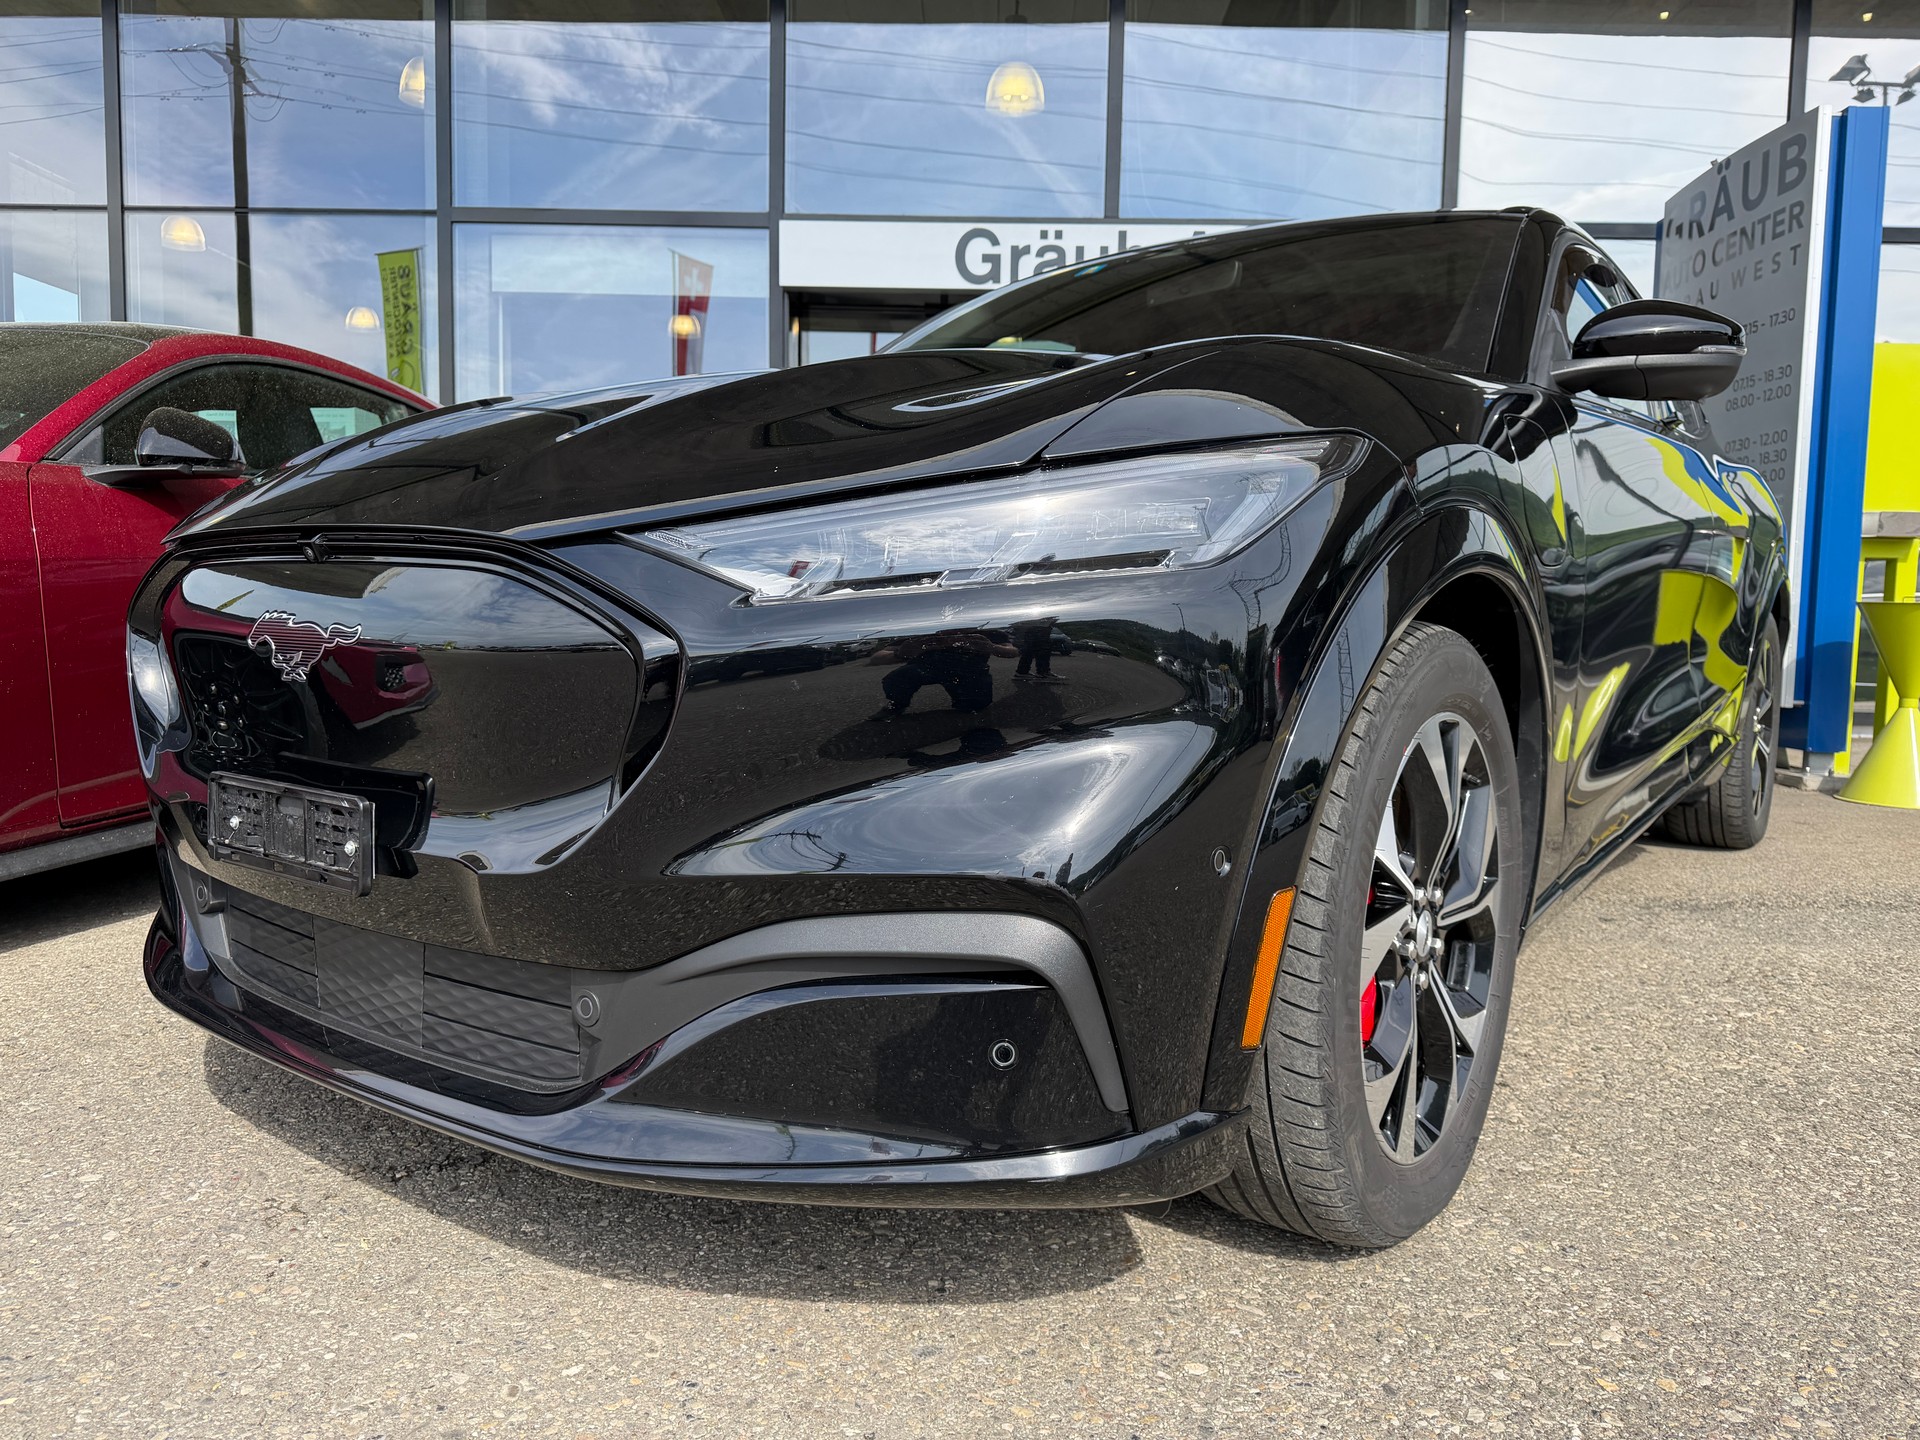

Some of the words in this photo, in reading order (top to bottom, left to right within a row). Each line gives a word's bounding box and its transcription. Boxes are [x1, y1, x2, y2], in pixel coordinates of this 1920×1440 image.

[1731, 243, 1802, 290] WEST
[1742, 319, 1759, 336] 7.15
[1769, 307, 1796, 328] 17.30
[1732, 374, 1756, 393] 07.15
[1764, 363, 1793, 383] 18.30
[1725, 392, 1755, 412] 08.00
[1763, 383, 1792, 402] 12.00
[1760, 428, 1788, 447] 12.00
[1759, 447, 1788, 466] 18.30
